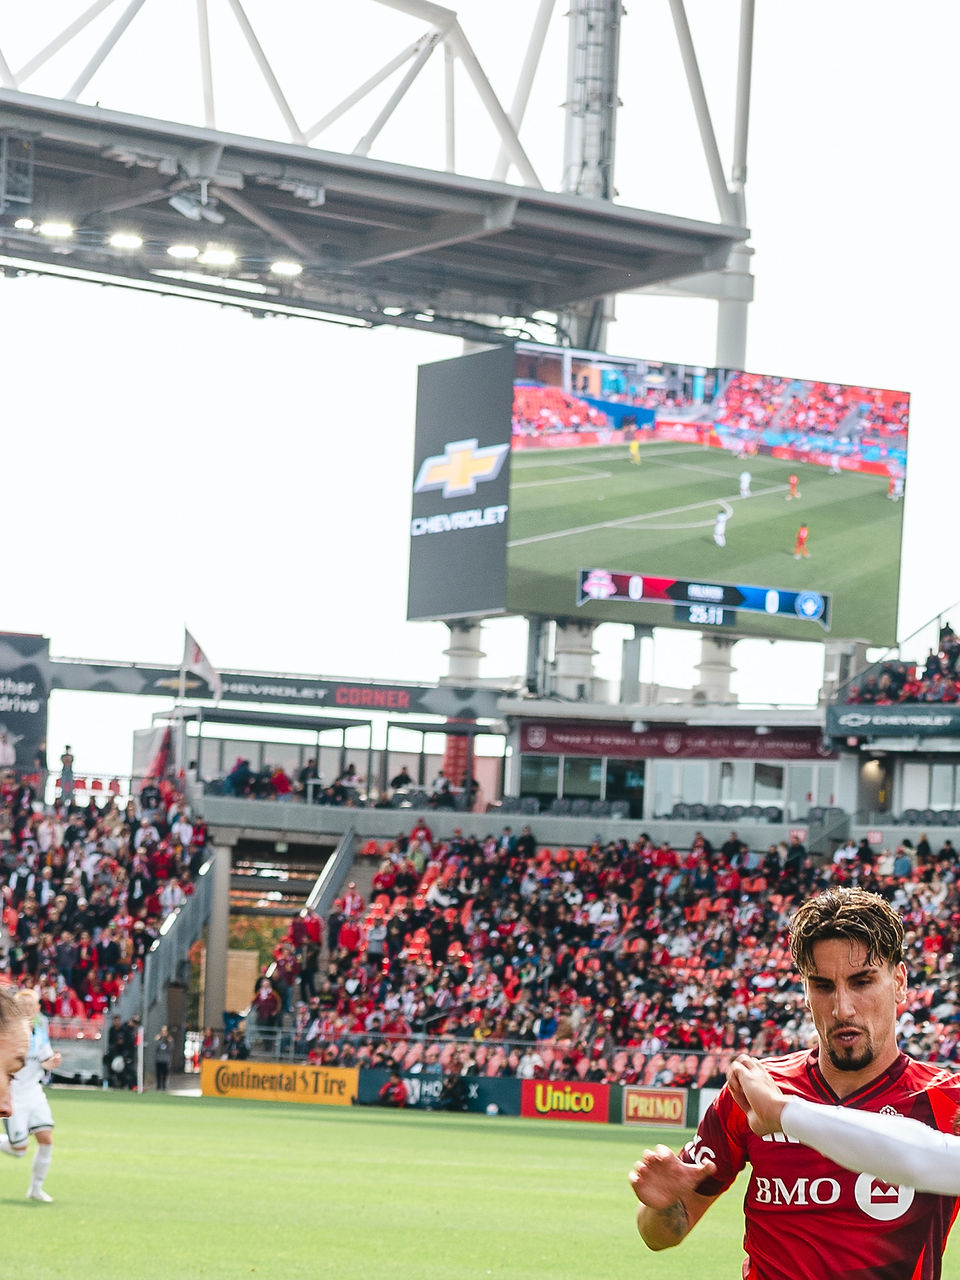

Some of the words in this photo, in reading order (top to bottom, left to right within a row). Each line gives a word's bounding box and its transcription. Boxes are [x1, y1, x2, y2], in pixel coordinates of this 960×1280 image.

[411, 504, 508, 536] CHEVROLET
[629, 575, 643, 600] 0
[765, 590, 780, 614] 0
[336, 688, 411, 708] CORNER
[872, 715, 952, 726] CHEVROLET
[214, 1065, 297, 1094] Continental
[312, 1071, 346, 1095] Tire
[535, 1084, 594, 1113] Unico
[628, 1095, 682, 1120] PRIMO
[756, 1177, 841, 1205] BMO
